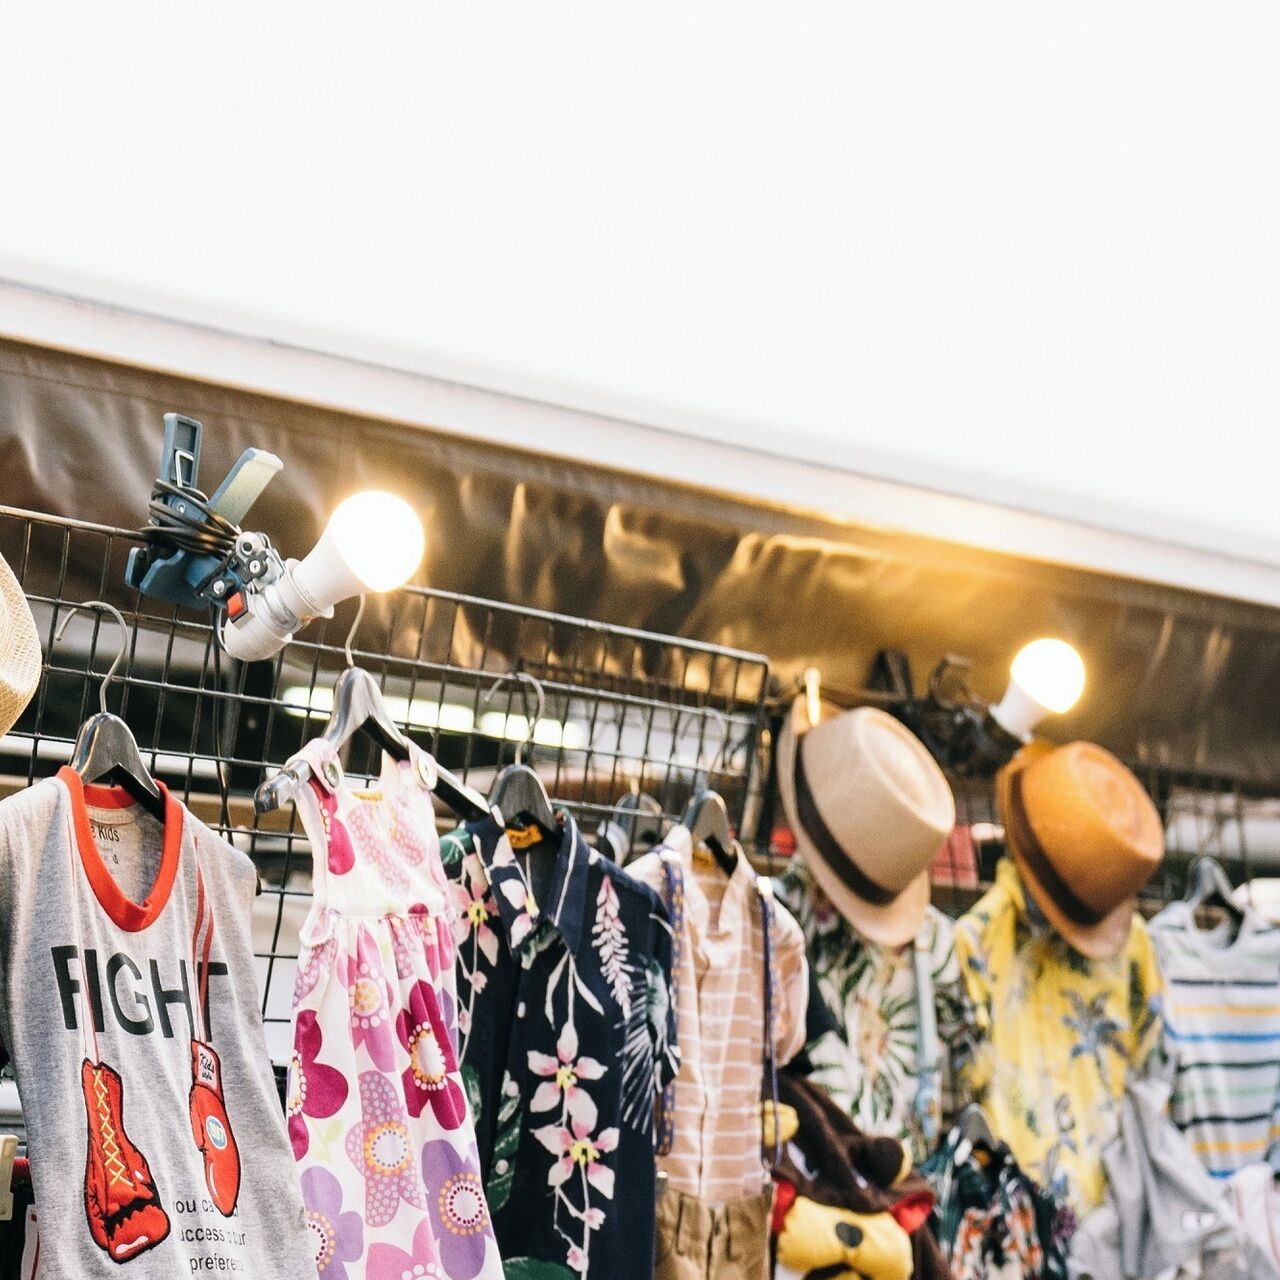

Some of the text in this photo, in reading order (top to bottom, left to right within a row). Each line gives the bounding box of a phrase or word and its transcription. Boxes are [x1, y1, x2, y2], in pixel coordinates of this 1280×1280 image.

[50, 944, 228, 1043] FIGHT
[173, 1200, 197, 1214] ou
[180, 1227, 225, 1242] uccess
